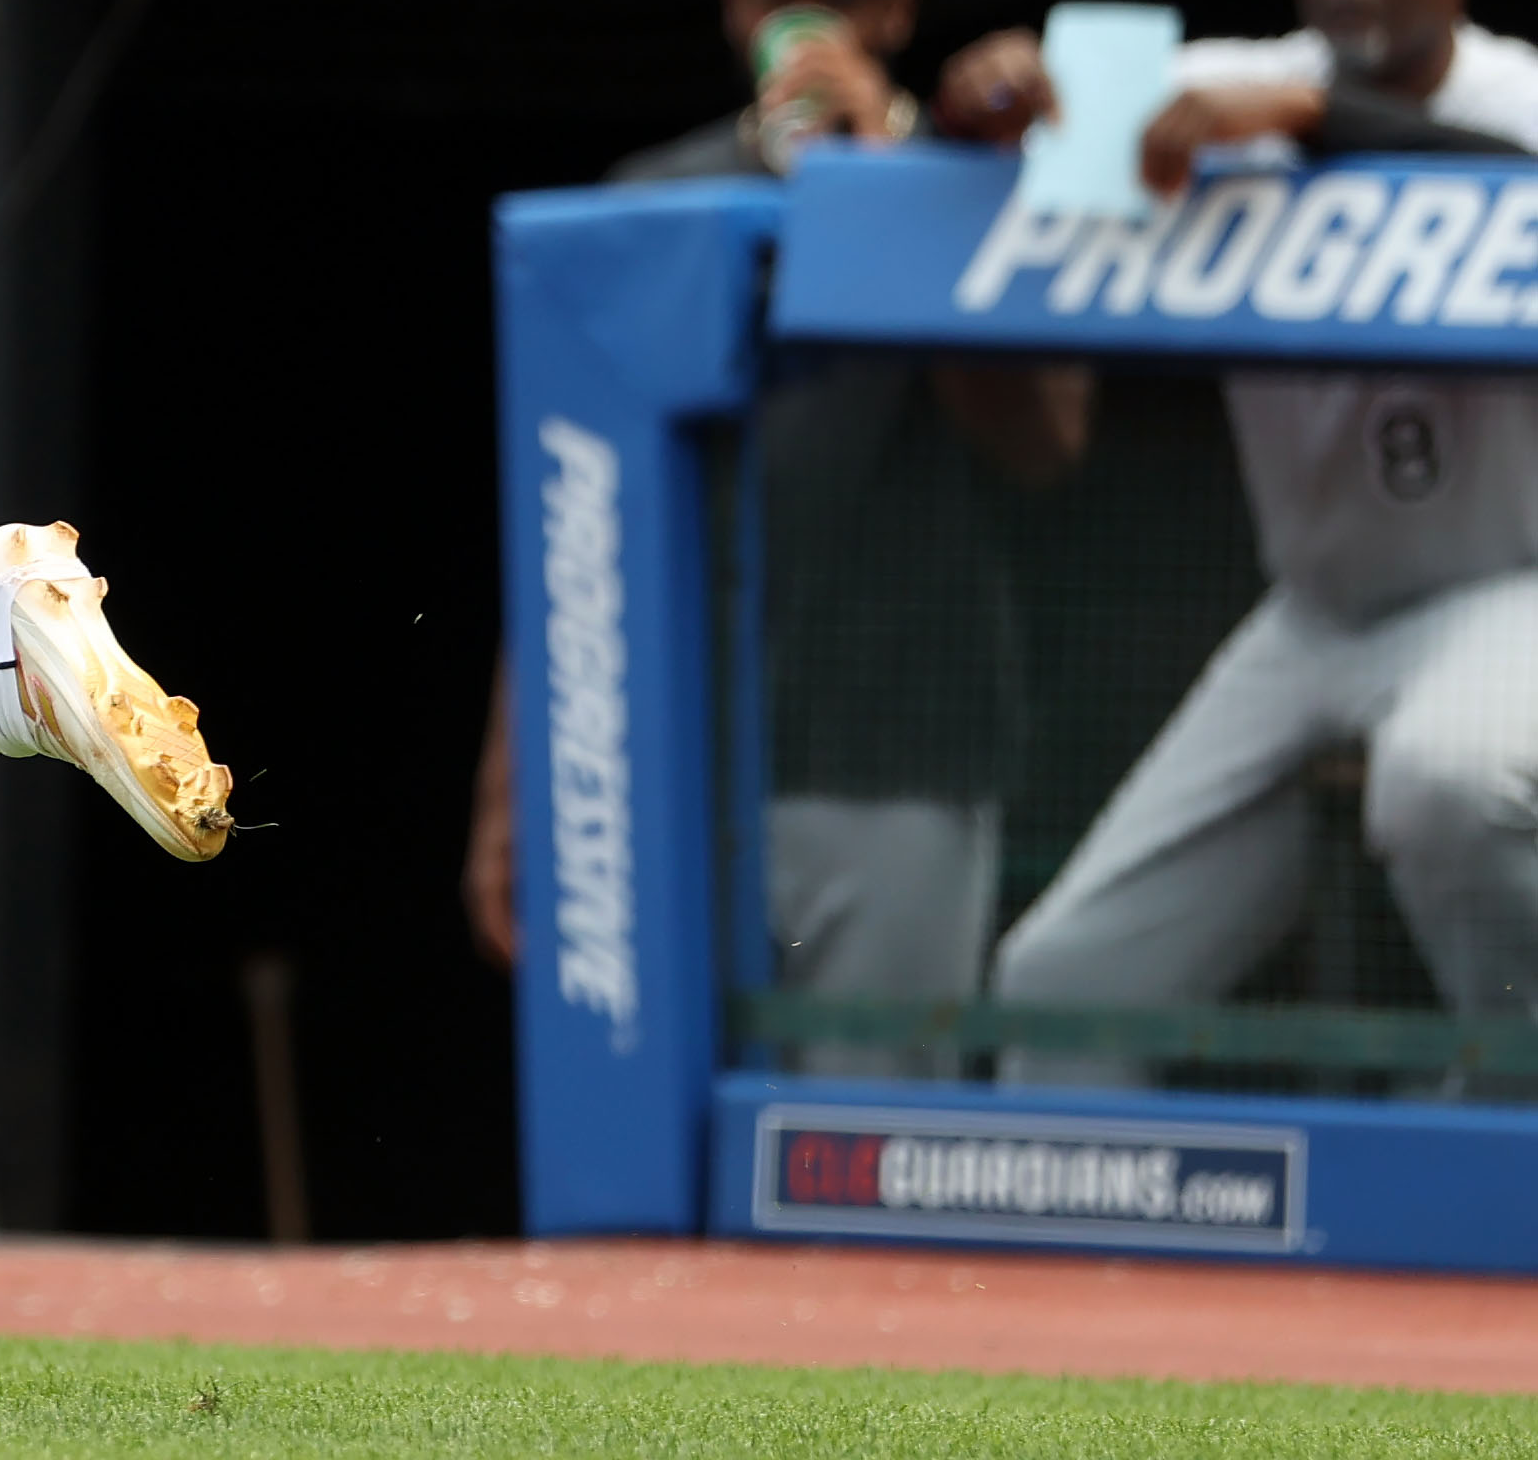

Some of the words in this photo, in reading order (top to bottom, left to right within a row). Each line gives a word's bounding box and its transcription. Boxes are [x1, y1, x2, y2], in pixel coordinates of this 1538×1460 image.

[951, 172, 1538, 328] PROGRE
[1377, 406, 1440, 503] 8
[537, 416, 638, 1026] PROGRESSIVE
